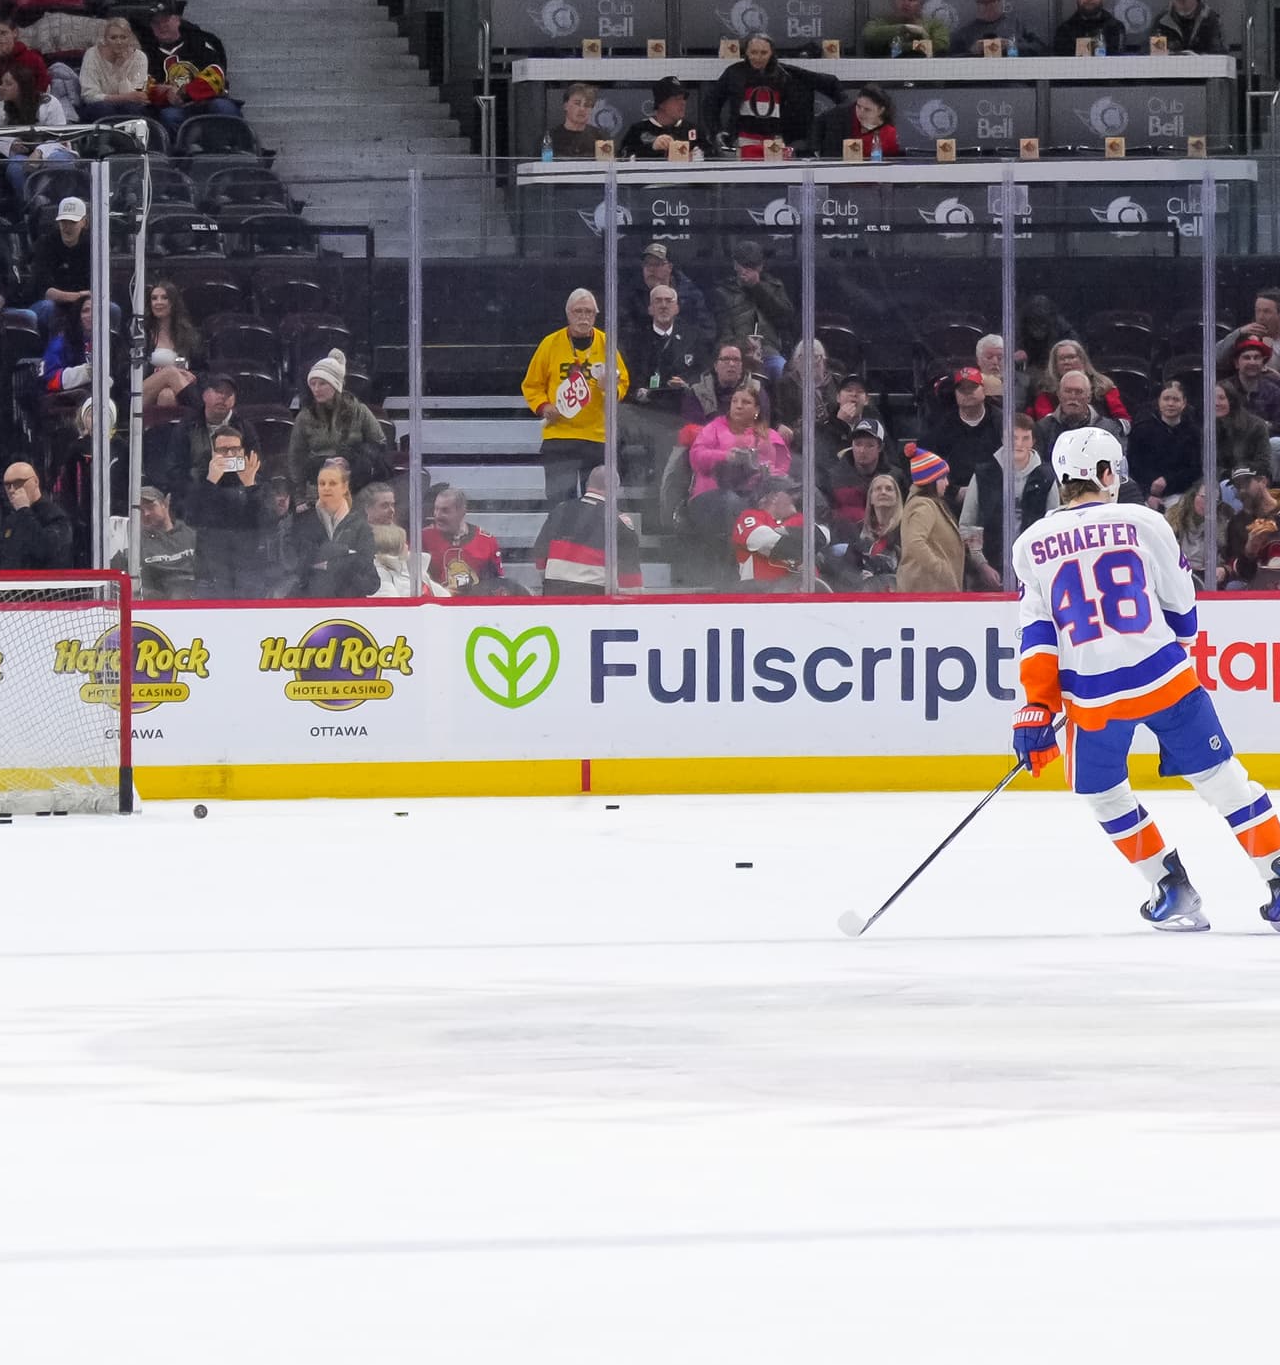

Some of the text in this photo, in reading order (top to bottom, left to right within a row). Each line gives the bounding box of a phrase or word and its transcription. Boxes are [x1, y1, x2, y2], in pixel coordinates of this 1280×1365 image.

[598, 17, 634, 38] Bell
[787, 18, 822, 38] Bell
[977, 118, 1014, 139] Bell
[1148, 115, 1185, 137] Bell
[652, 199, 690, 217] Club
[823, 199, 859, 217] Club
[992, 198, 1032, 216] Cub
[1031, 523, 1140, 565] SCHAEFER
[1050, 549, 1153, 647] 48
[135, 637, 210, 679] Rock
[258, 636, 414, 676] Hard Rock
[589, 626, 1016, 722] Fullscript
[88, 687, 183, 698] HOTE CASINO
[292, 683, 325, 696] HOTEL
[339, 683, 387, 696] CASINO
[1014, 711, 1045, 724] RIOR
[105, 728, 164, 740] OTAWA
[309, 725, 369, 737] OTTAWA
